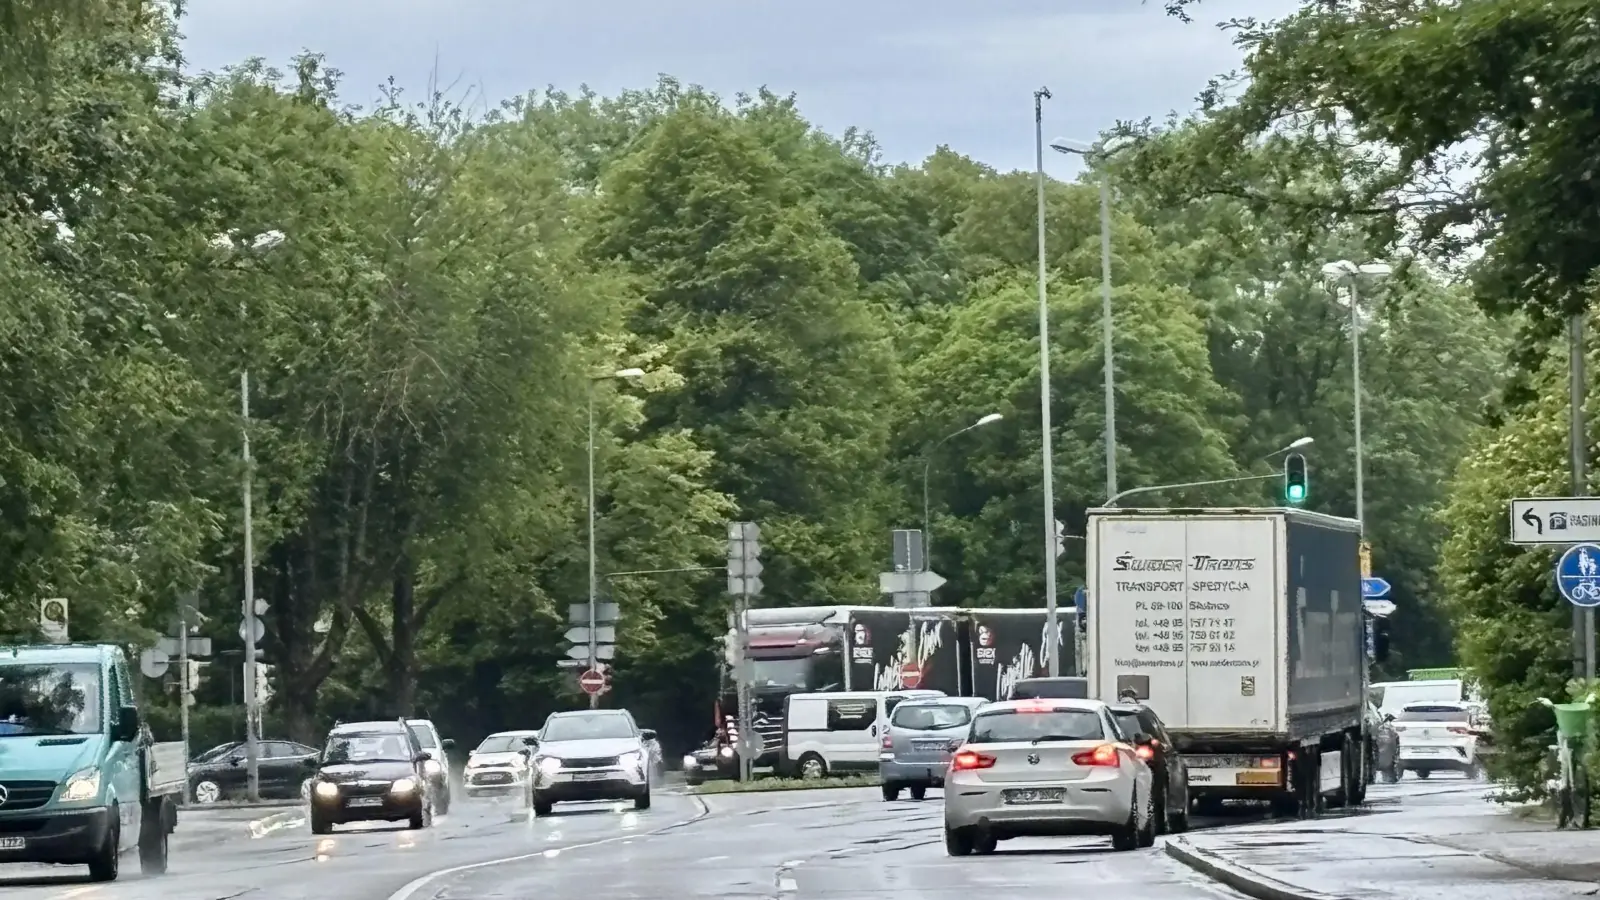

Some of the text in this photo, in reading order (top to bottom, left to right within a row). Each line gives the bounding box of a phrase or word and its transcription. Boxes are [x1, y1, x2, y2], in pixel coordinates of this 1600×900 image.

[1570, 514, 1600, 527] PASIN
[1115, 581, 1184, 592] TRANSPORT
[1135, 601, 1148, 611] PL
